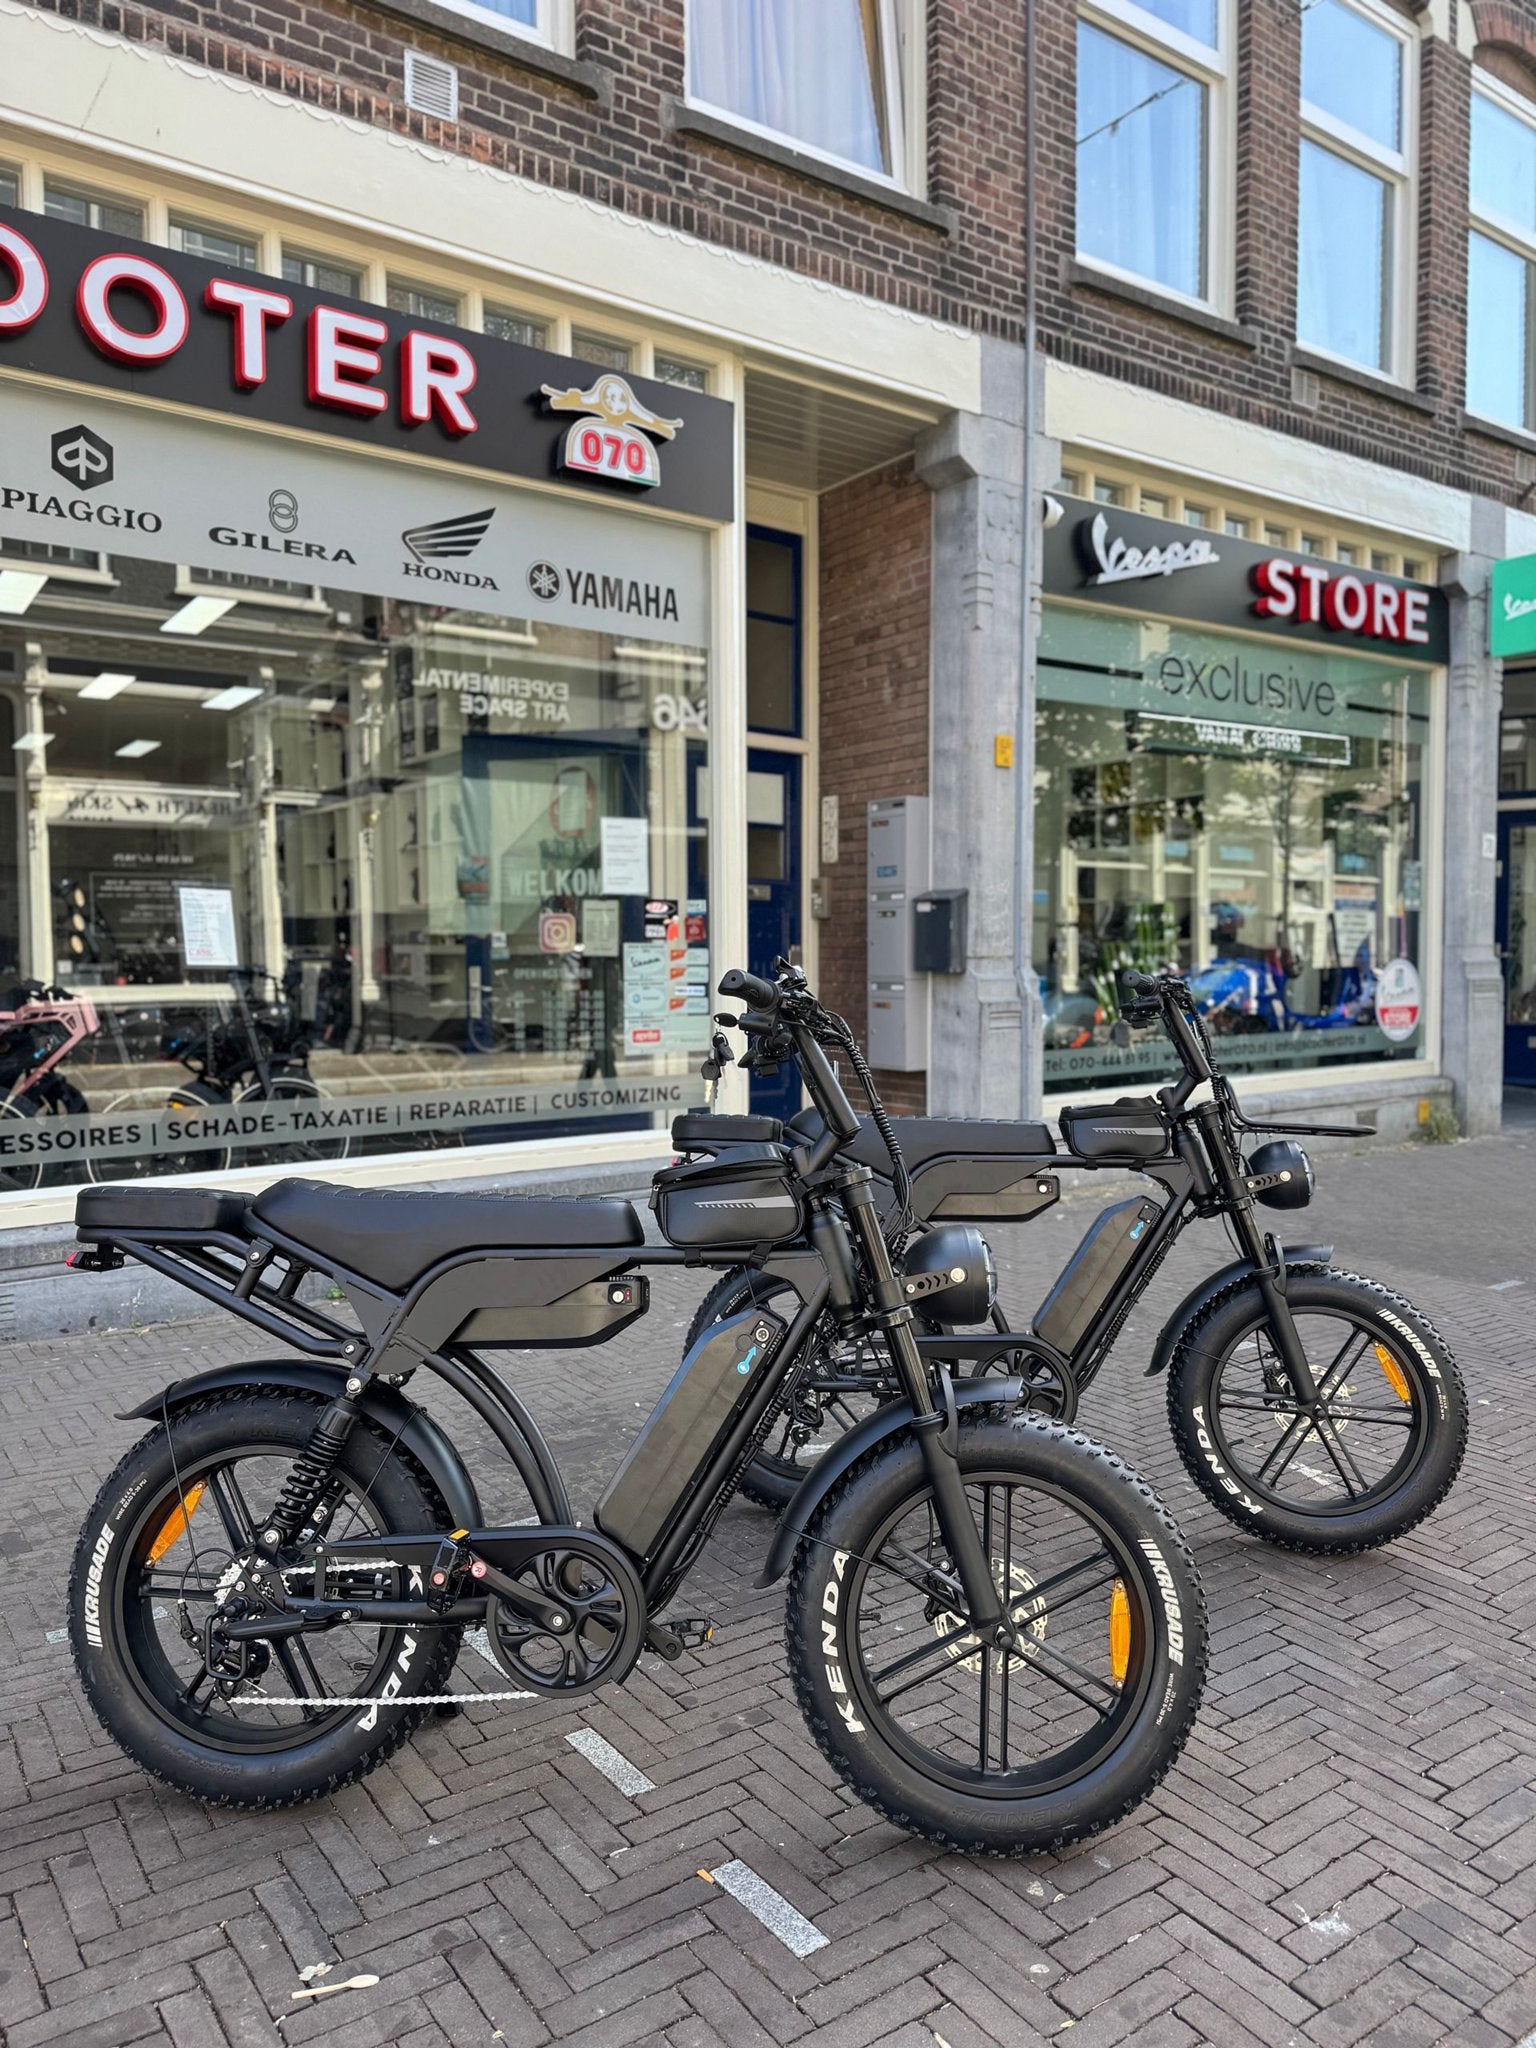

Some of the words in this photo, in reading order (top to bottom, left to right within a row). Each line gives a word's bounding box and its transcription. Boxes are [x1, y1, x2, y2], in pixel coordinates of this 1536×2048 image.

[580, 429, 646, 474] 070
[1, 487, 162, 533] PIAGGIO
[208, 526, 357, 565] GILERA
[401, 561, 500, 592] HONDA
[1091, 511, 1220, 585] Vespa
[565, 568, 680, 622] YAMAHA
[1256, 558, 1430, 643] STORE
[1159, 656, 1336, 717] exclusive
[508, 868, 602, 896] WELKOM
[0, 1124, 141, 1155] ESSOIRES
[167, 1106, 388, 1141] SCHADE-TAXATIE
[410, 1096, 526, 1121] REPARATIE
[551, 1086, 681, 1110] CUSTOMIZING
[1389, 1317, 1442, 1378] KRUSADE
[1192, 1405, 1264, 1515] KENDA
[85, 1522, 115, 1625] KRUSADE
[821, 1550, 866, 1733] KENDA
[1149, 1558, 1184, 1667] KRUSADE
[356, 1564, 423, 1732] KNDA
